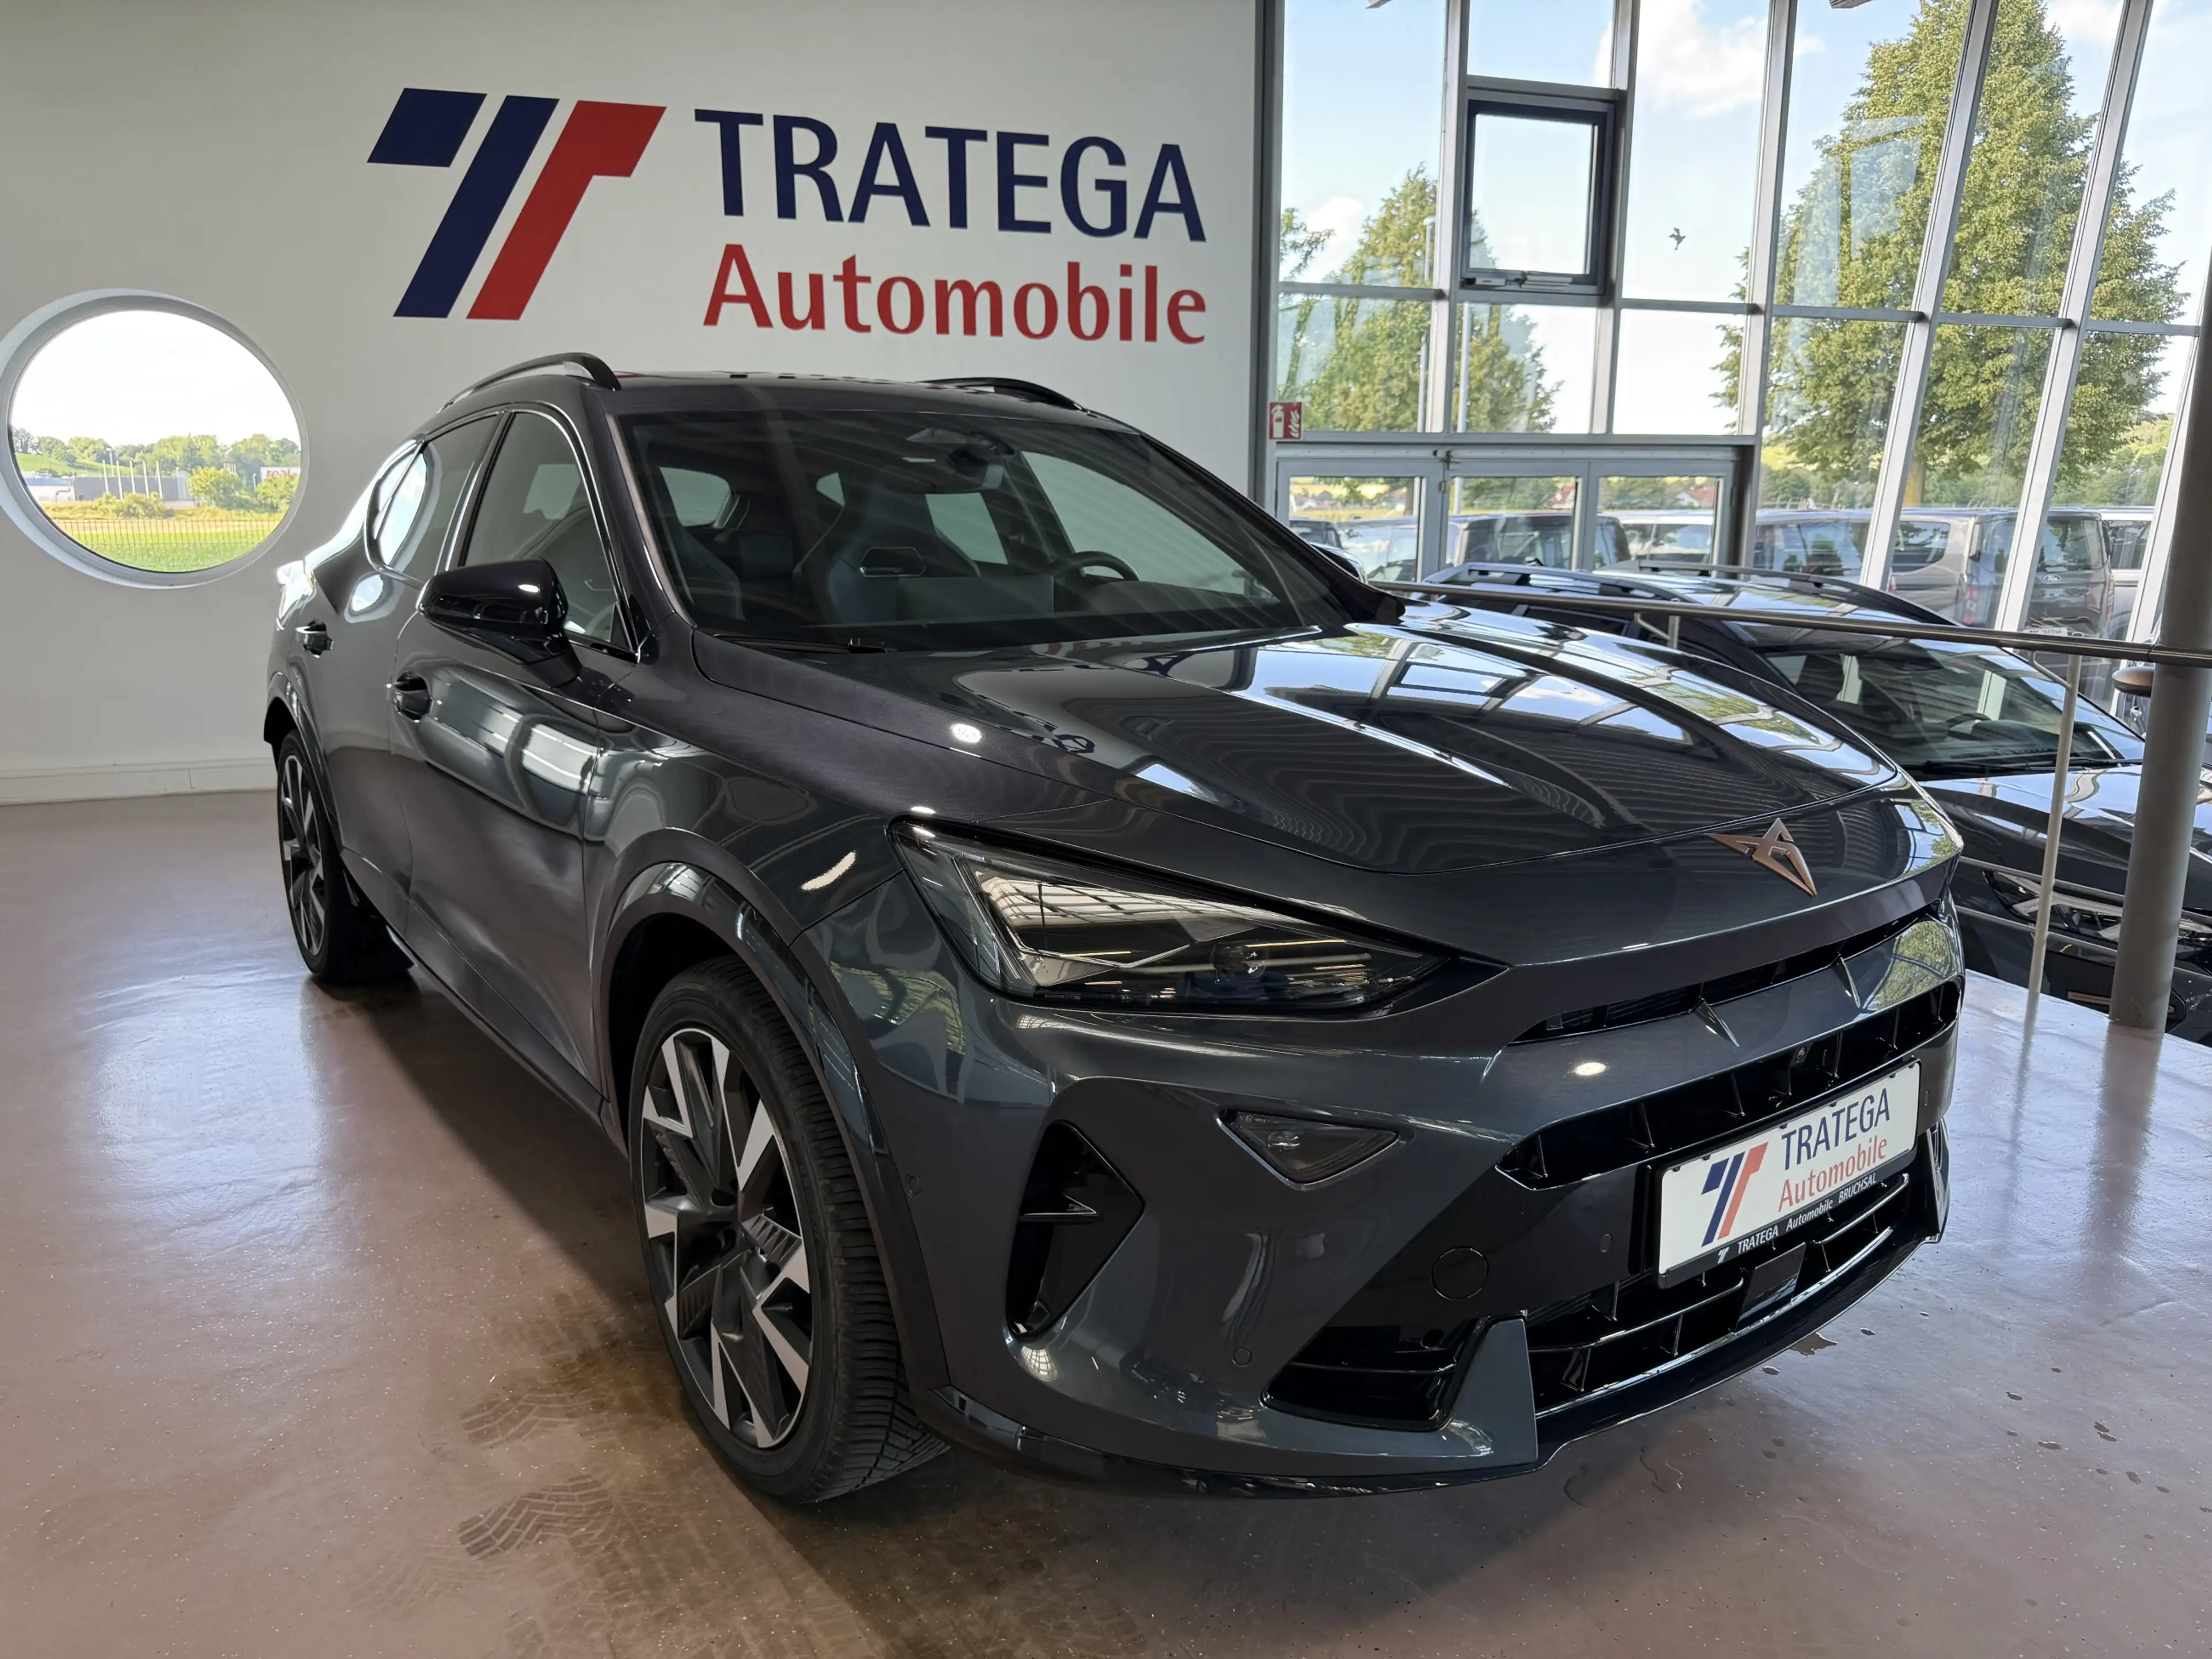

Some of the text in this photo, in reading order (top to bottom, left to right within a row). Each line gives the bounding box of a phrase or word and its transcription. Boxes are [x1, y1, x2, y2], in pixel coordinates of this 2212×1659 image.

[695, 109, 1206, 242] TRATEGA
[703, 244, 1206, 344] Automobile
[1782, 1088, 1890, 1170] TRATEGA
[1738, 1172, 1876, 1254] TRATEGA Automobile BRUCHSAL
[1778, 1135, 1887, 1212] Automobile
